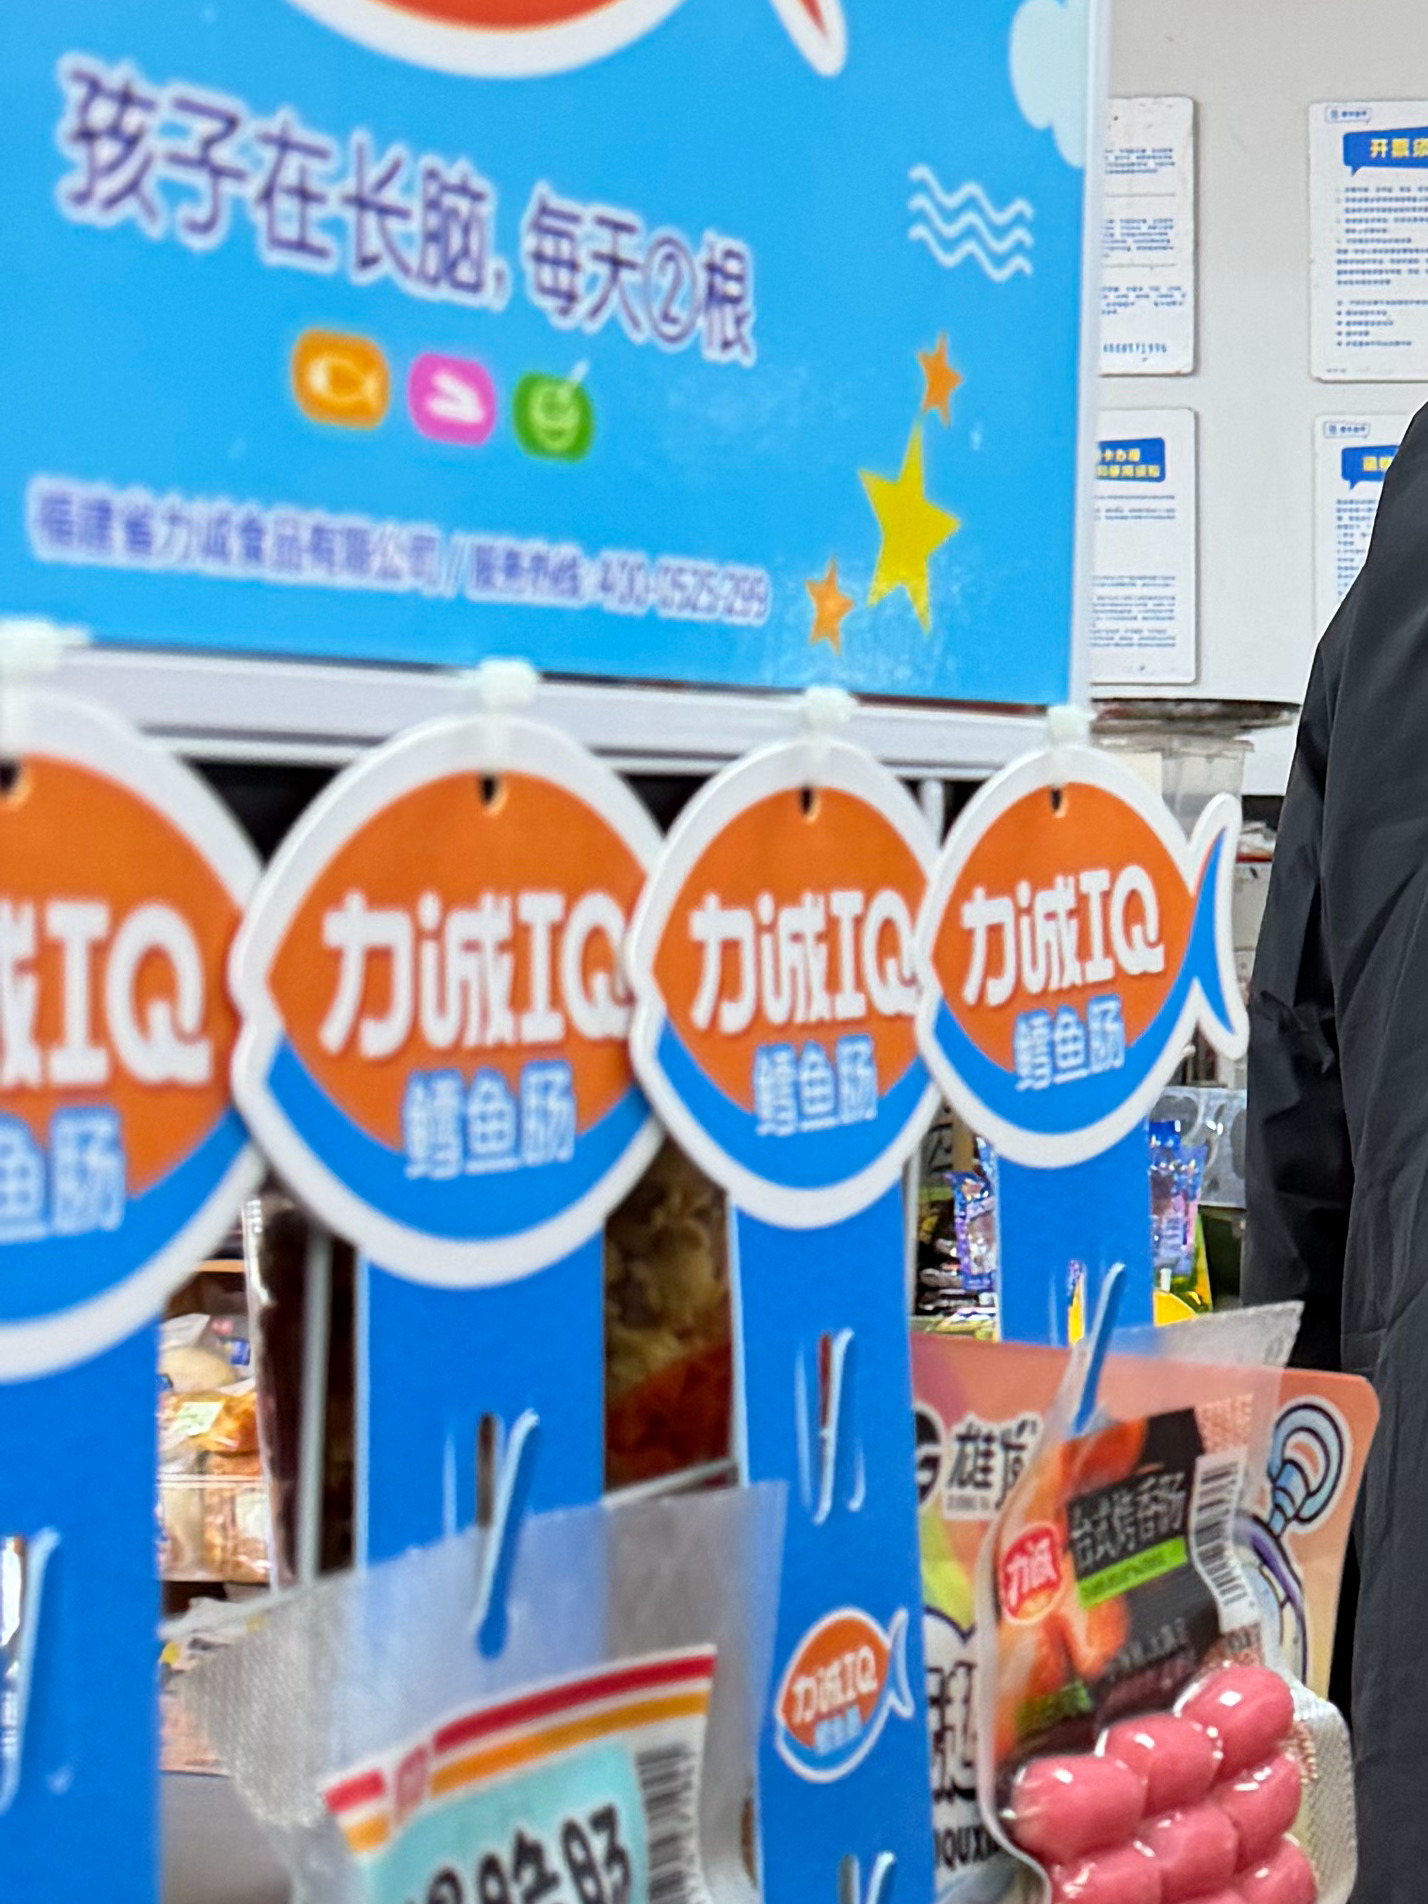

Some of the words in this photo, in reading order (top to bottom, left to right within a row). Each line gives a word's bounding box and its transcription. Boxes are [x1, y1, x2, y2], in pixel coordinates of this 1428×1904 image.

[323, 889, 630, 1061] 力诚IQ
[690, 889, 918, 1034] 力诚IQ
[959, 864, 1164, 1006] 力诚IQ
[754, 1035, 877, 1136] 鳕鱼肠
[1013, 994, 1127, 1093] 鳕鱼肠
[404, 1059, 576, 1182] 鳕鱼肠
